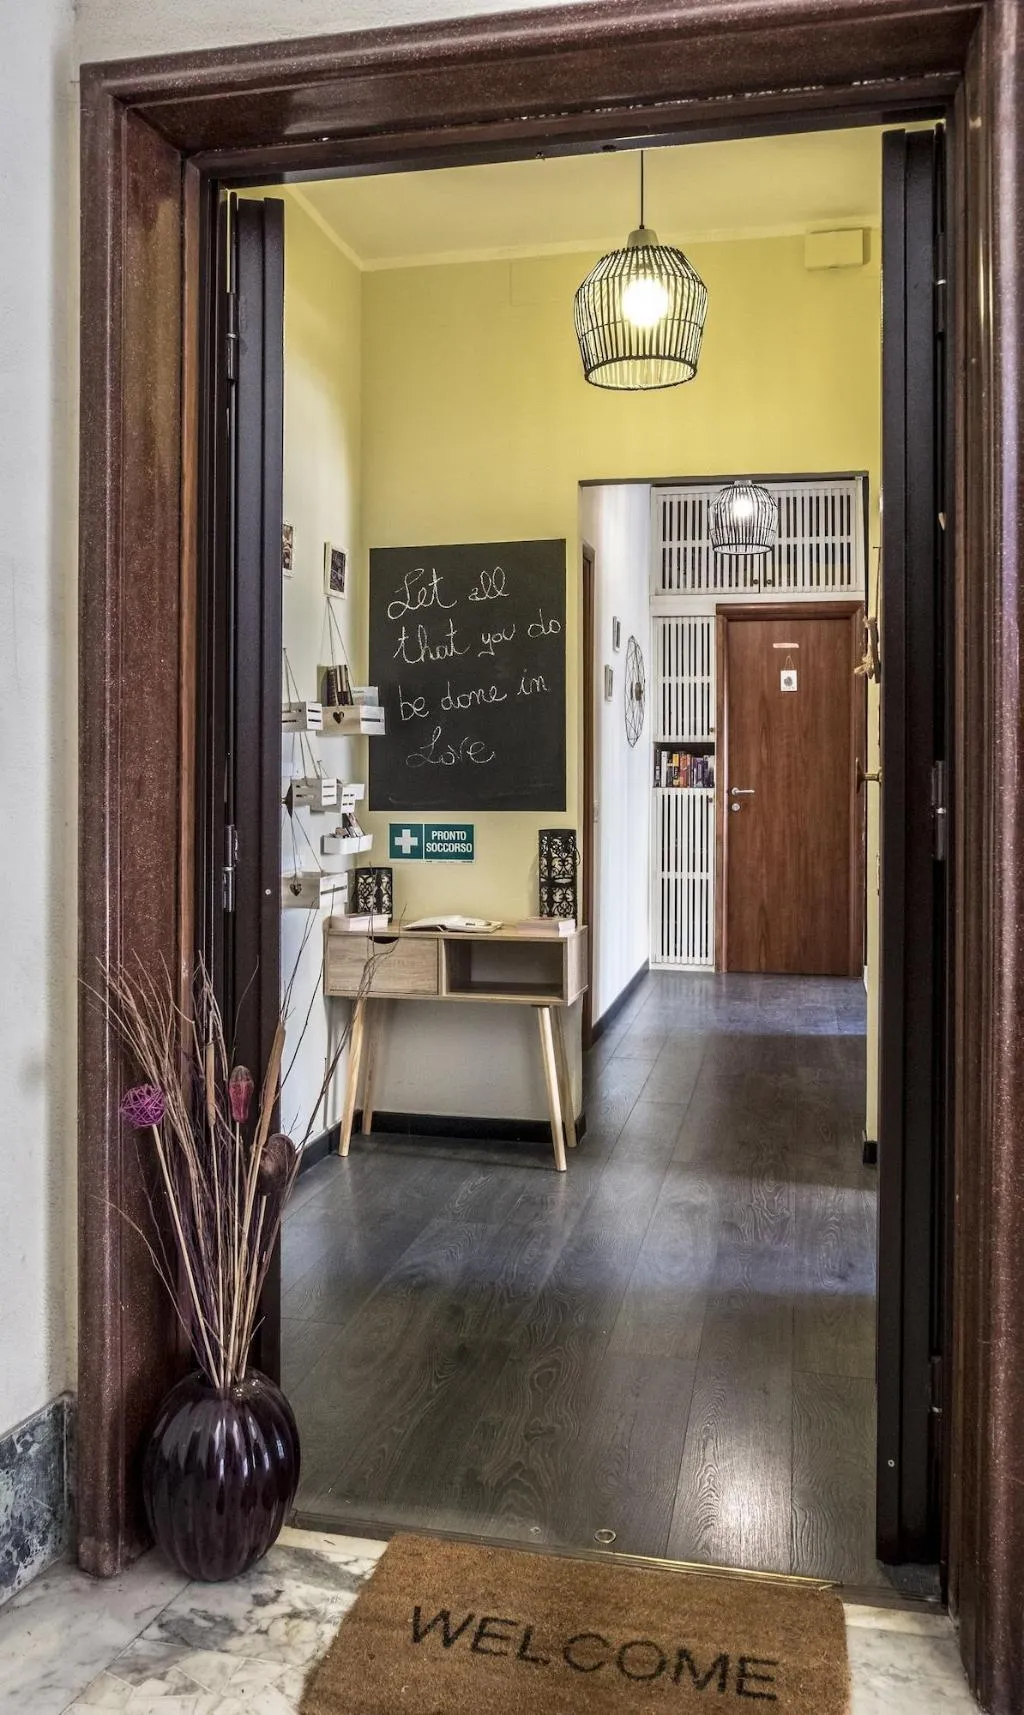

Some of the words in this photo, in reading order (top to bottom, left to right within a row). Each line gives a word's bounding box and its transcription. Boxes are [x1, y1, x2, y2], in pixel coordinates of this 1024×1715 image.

[388, 568, 457, 620] Let
[468, 566, 509, 601] all
[393, 618, 471, 664] that
[478, 624, 516, 658] you
[527, 608, 562, 638] do
[399, 685, 429, 721] be
[441, 681, 508, 711] done
[517, 668, 549, 696] in
[406, 726, 496, 768] Love
[425, 842, 473, 853] SOCCORSO
[431, 830, 467, 841] PRONTO
[410, 1605, 780, 1701] WELCOME
